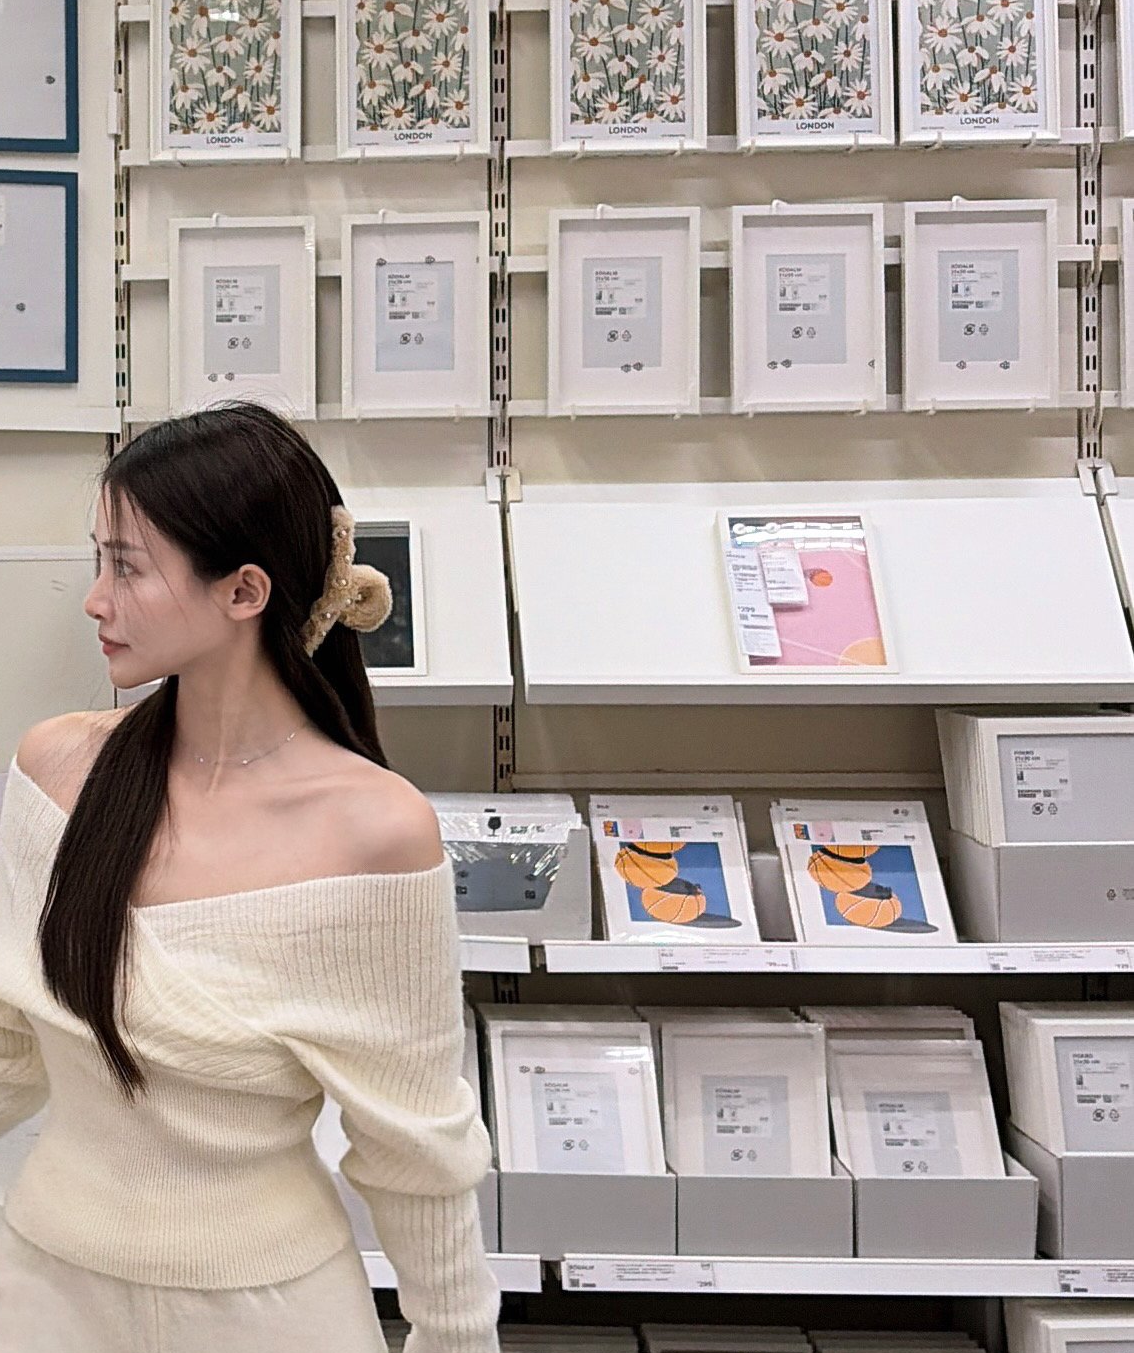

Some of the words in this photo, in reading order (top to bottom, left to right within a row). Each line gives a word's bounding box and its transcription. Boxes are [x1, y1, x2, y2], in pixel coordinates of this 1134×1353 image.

[796, 121, 835, 130] LONDON
[960, 116, 1000, 126] LONDON
[608, 125, 648, 134] LONDON
[206, 136, 244, 144] LONDON
[394, 131, 432, 141] LONDON
